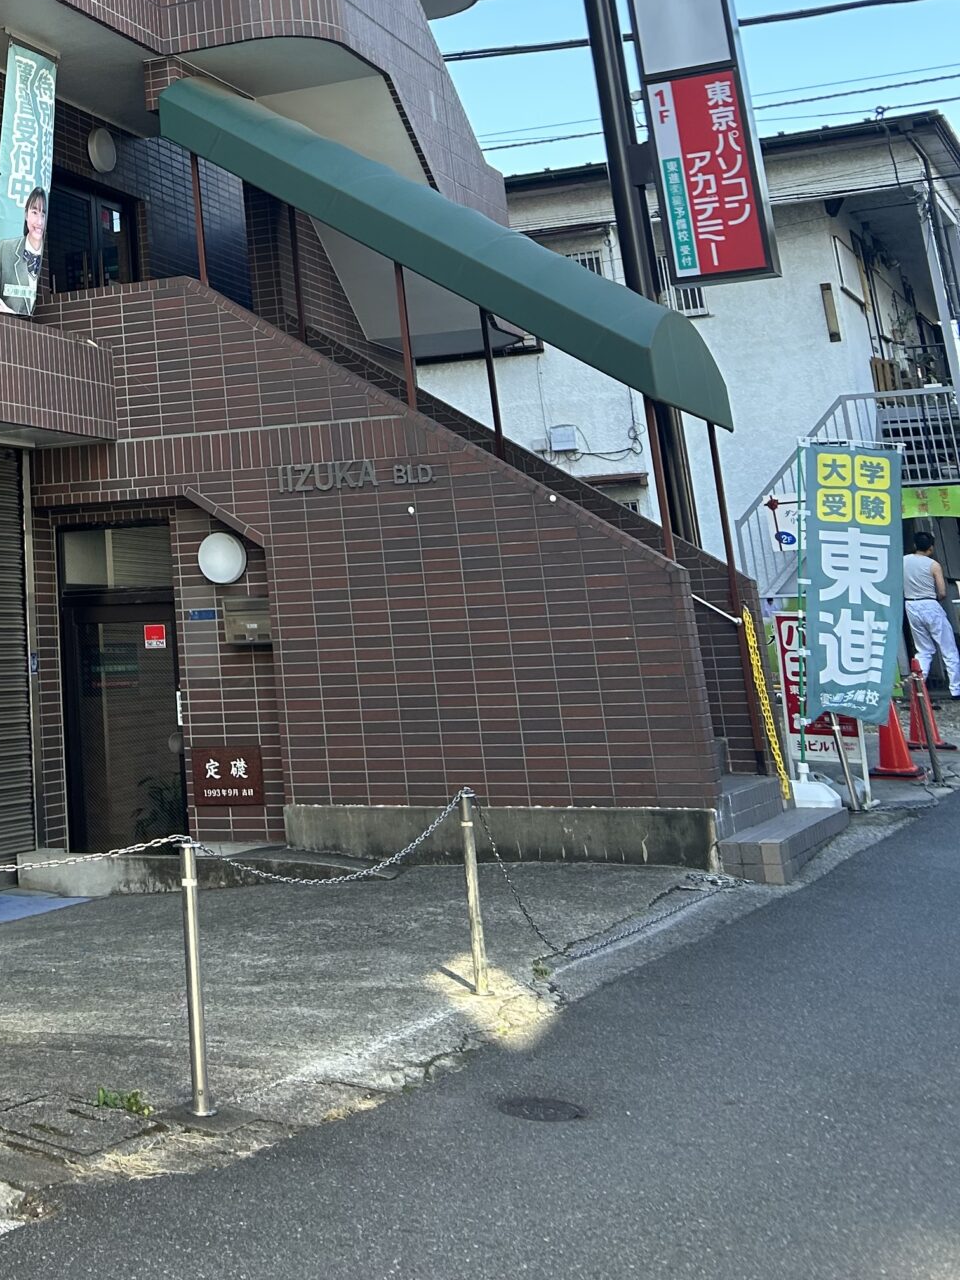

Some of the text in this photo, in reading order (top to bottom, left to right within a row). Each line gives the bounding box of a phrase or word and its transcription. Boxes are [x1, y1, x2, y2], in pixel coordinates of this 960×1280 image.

[653, 89, 670, 124] 1F
[704, 80, 751, 226] 東京パソコン
[686, 151, 725, 266] アカデミー
[277, 460, 379, 493] IIZUKA
[819, 527, 890, 686] 東進
[205, 757, 249, 780] 定礎
